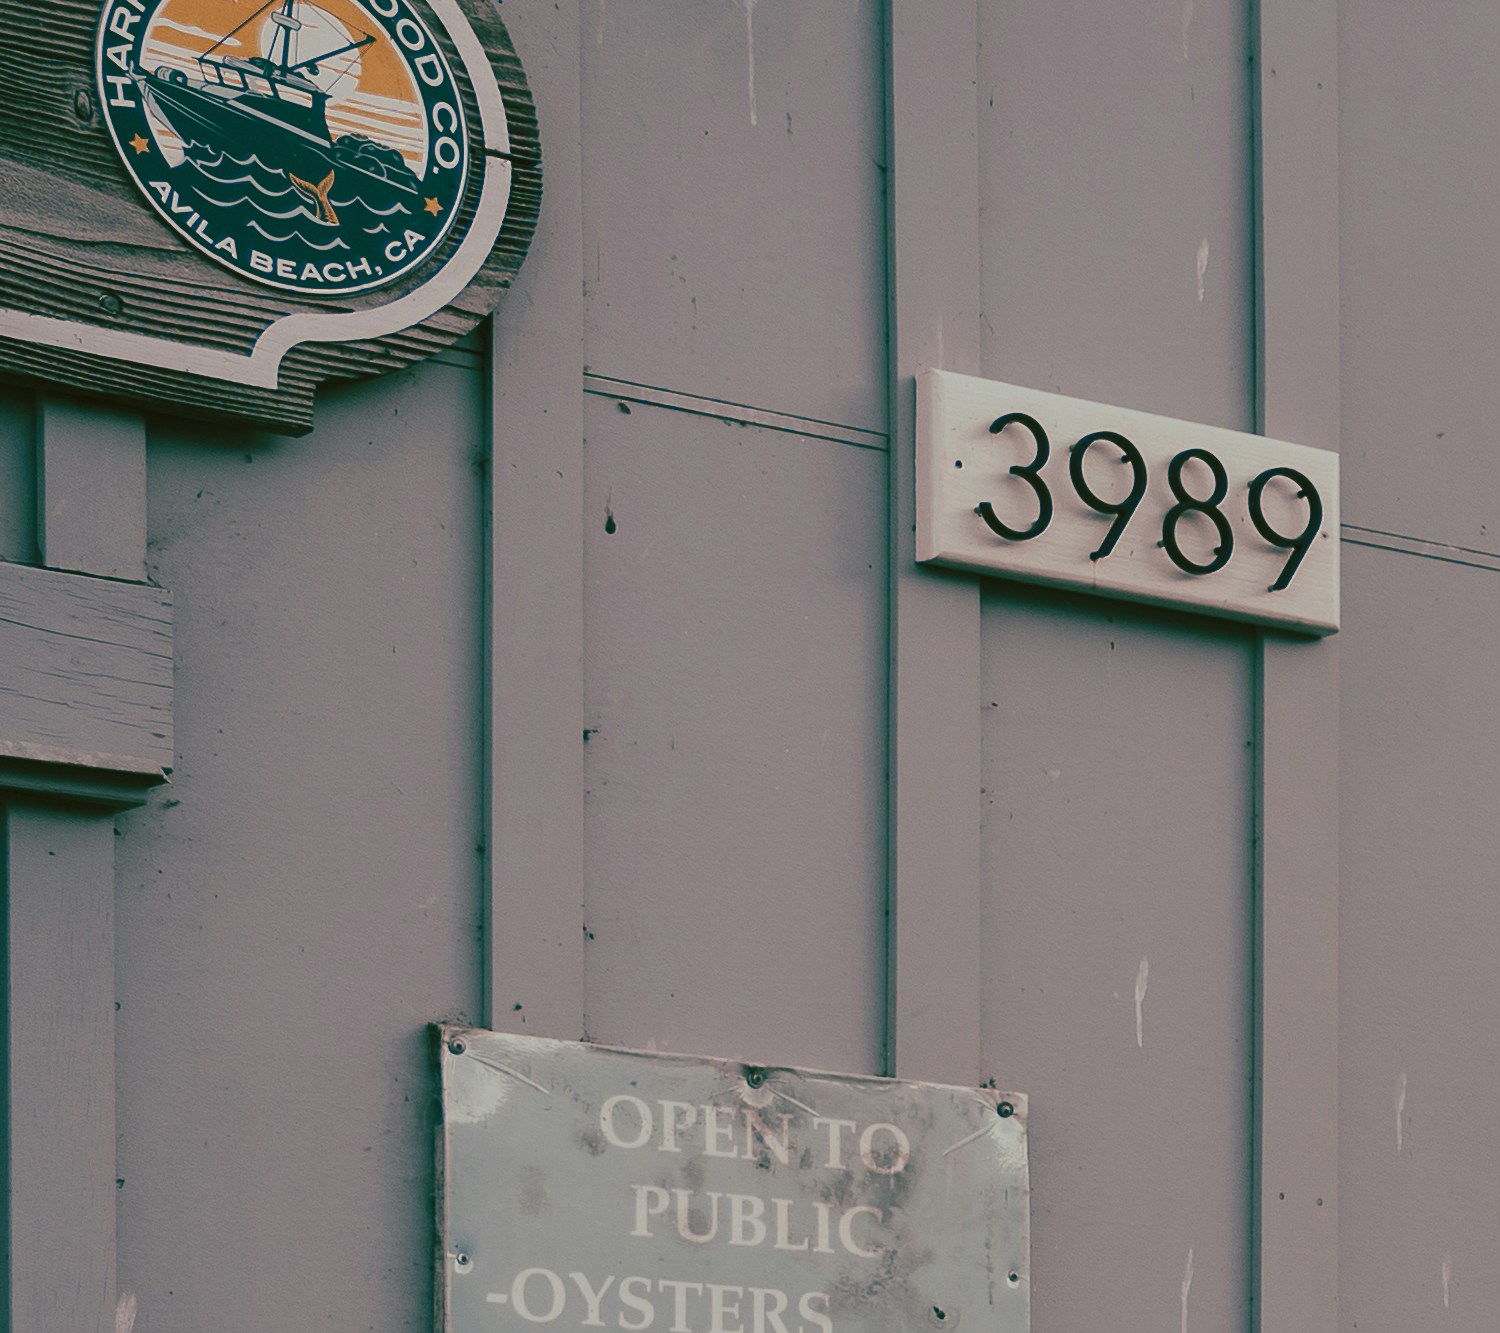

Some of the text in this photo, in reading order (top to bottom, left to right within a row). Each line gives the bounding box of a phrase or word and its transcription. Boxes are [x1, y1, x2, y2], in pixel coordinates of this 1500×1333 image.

[106, 0, 460, 174] HAR OOD CO.
[148, 181, 426, 284] AVILA BEACH, CA
[979, 412, 1323, 592] 3989
[600, 1094, 910, 1176] OPEN TO
[630, 1184, 888, 1259] PUBLIC
